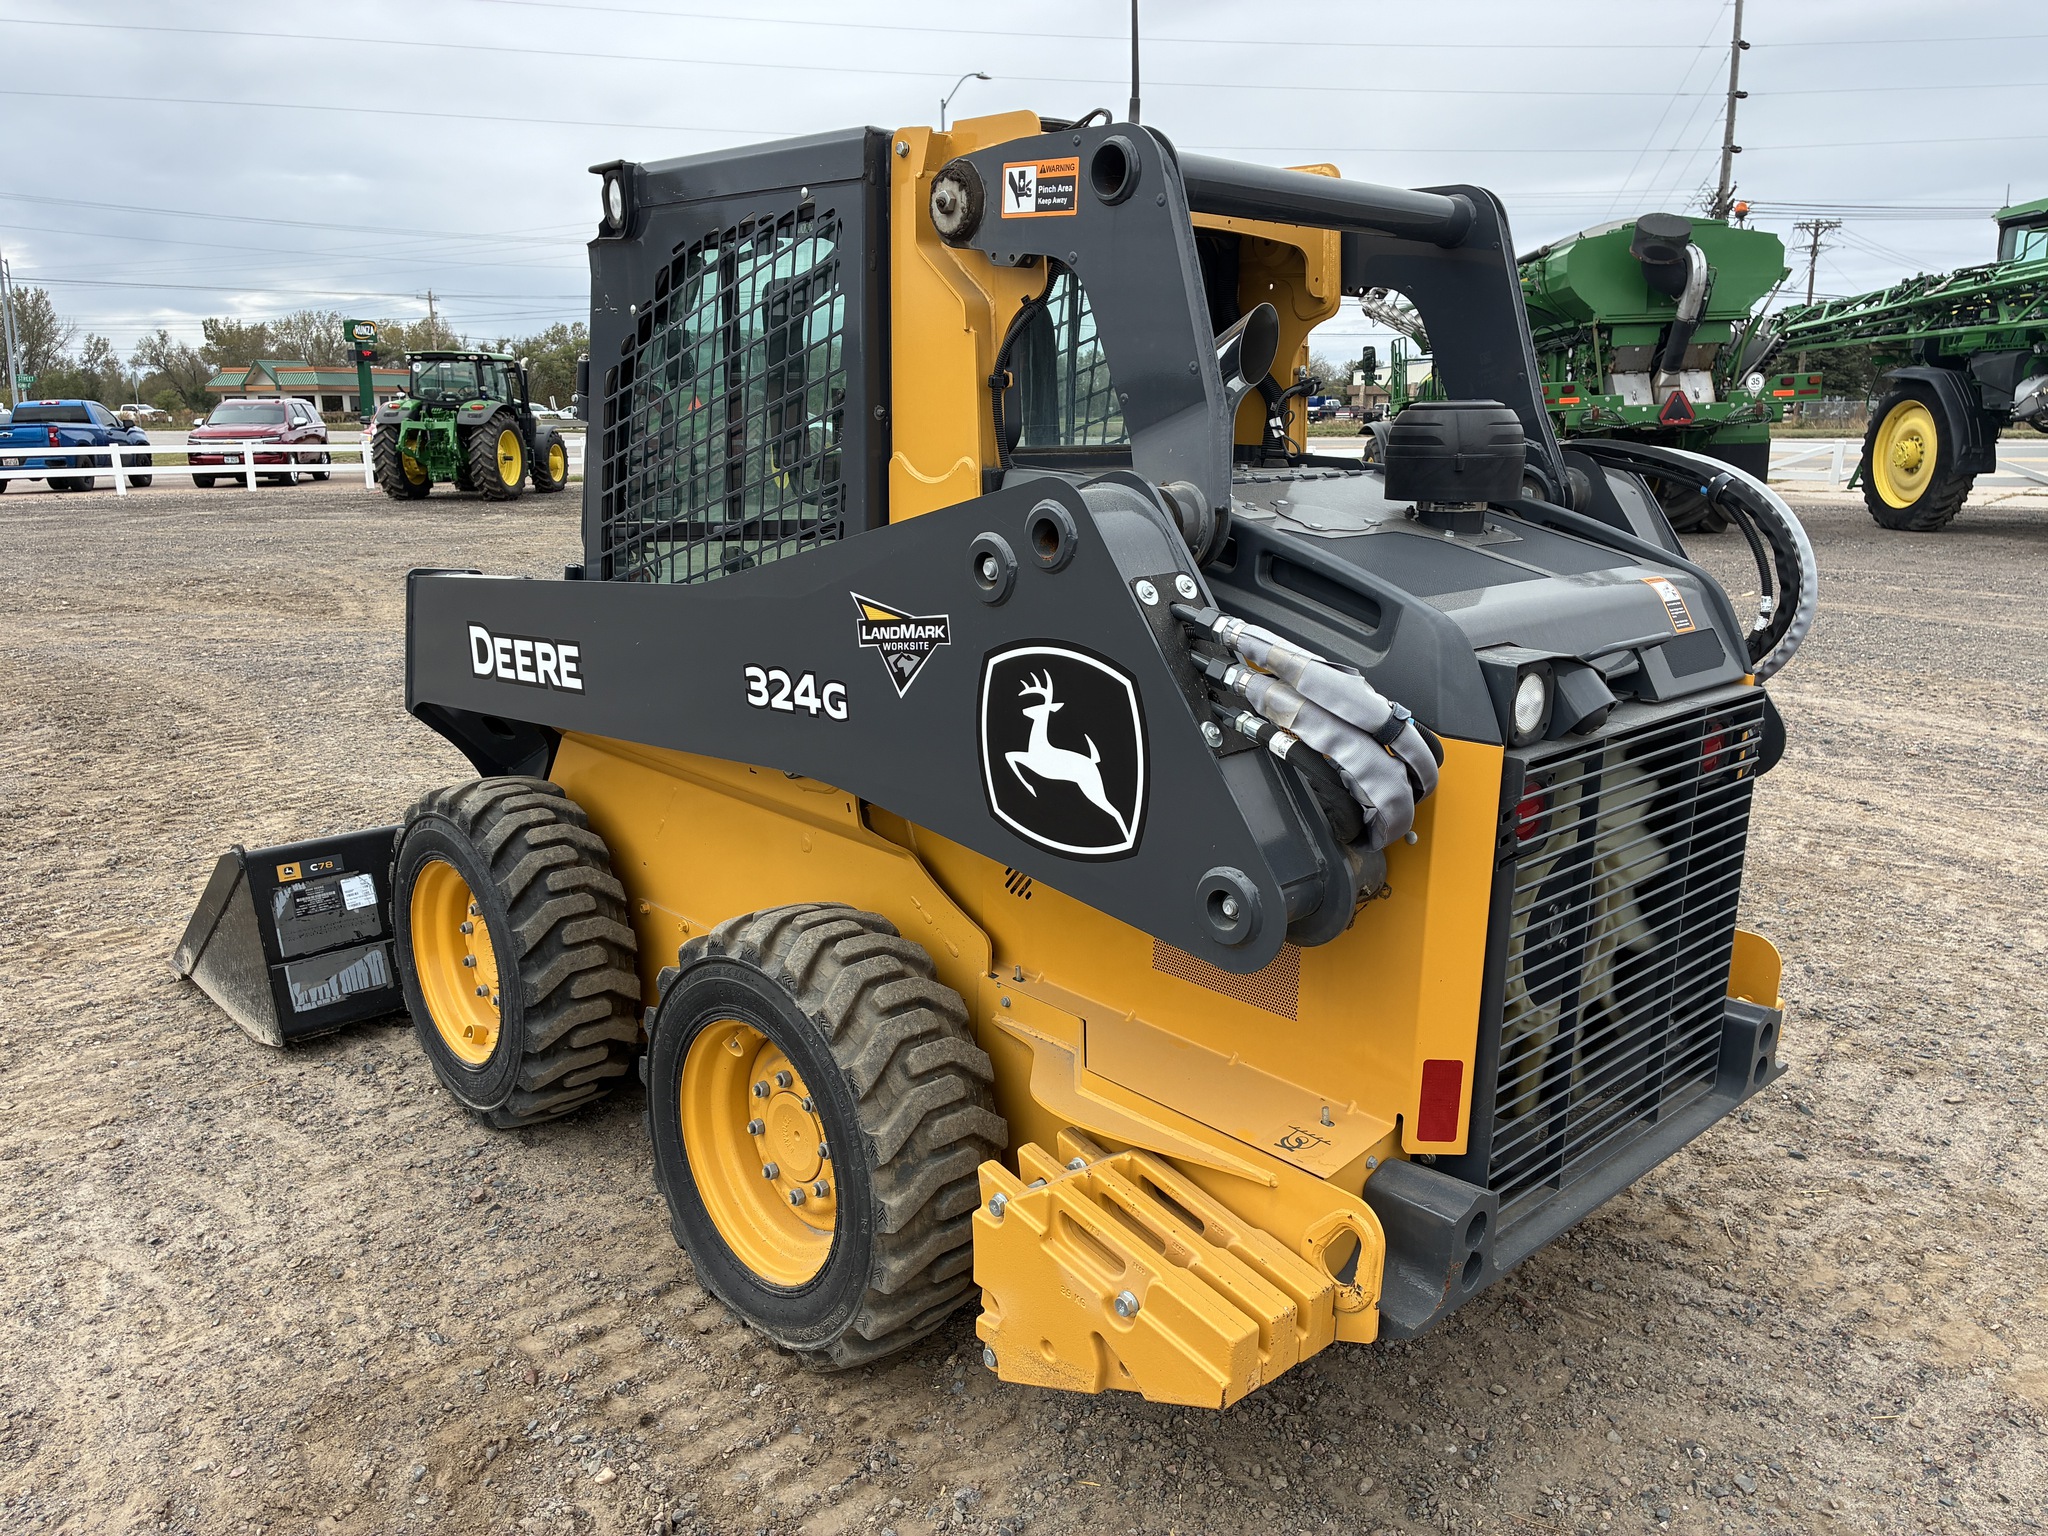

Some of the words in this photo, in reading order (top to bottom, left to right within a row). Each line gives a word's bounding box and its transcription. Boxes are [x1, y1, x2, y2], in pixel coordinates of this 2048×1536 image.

[1046, 163, 1075, 172] WARNING
[1038, 185, 1056, 194] Pinch
[1057, 184, 1073, 192] Area
[1038, 197, 1052, 205] Keep
[355, 325, 375, 336] RUNZA
[1751, 377, 1760, 385] 35
[882, 641, 930, 651] WORKSITE
[468, 624, 583, 690] DEERE
[745, 665, 848, 721] 324G
[310, 860, 334, 872] C78
